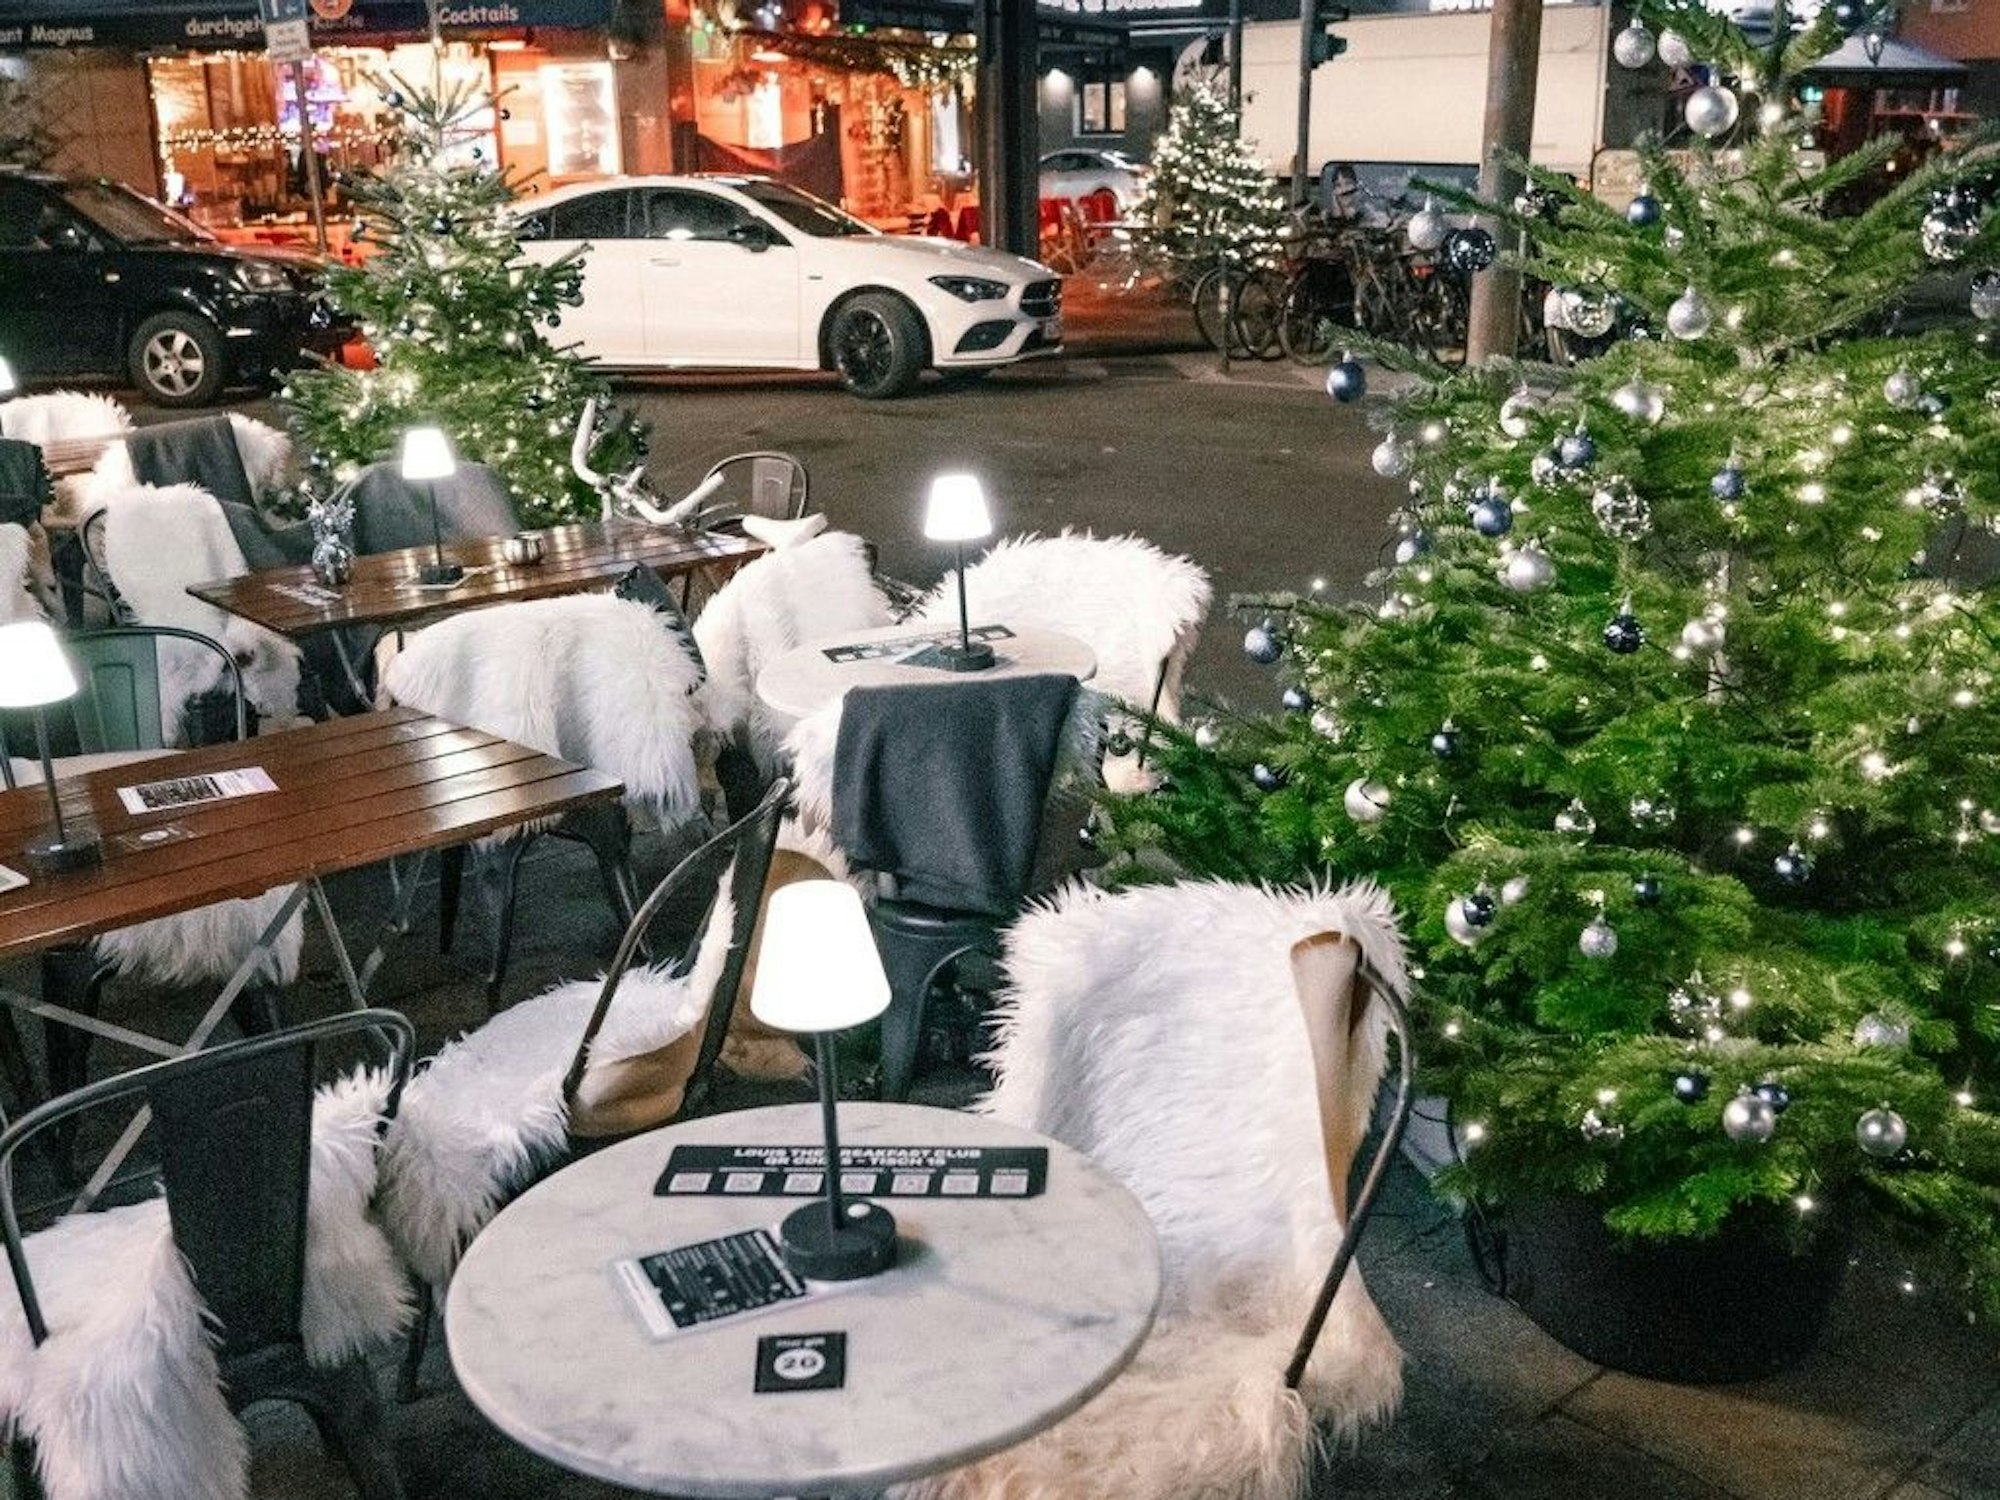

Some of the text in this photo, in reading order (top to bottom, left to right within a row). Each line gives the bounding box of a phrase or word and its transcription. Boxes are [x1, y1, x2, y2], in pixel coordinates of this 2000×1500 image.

[440, 4, 519, 24] Cocktails
[31, 25, 93, 46] Magnus
[734, 1147, 981, 1158] LOUIS THE REAKFAST CLUB
[793, 1157, 852, 1166] CODS
[870, 1157, 922, 1166] TISCH
